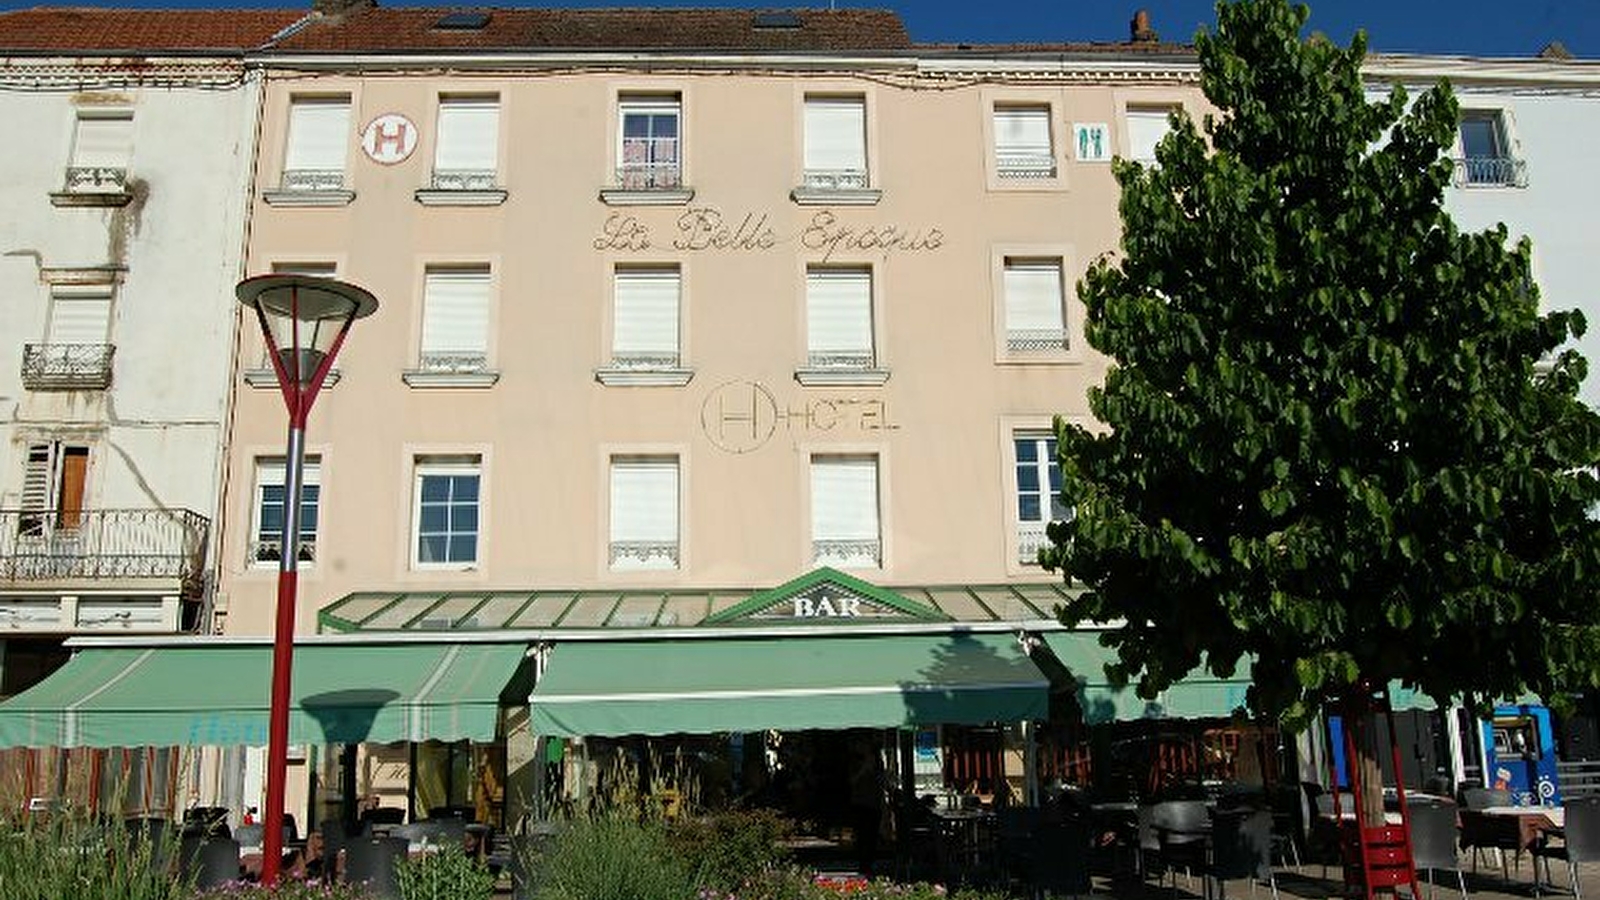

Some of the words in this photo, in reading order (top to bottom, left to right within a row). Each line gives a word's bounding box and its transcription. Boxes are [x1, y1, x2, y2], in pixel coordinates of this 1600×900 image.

[372, 122, 407, 155] H
[593, 211, 651, 251] La
[673, 208, 776, 251] Belle
[786, 399, 901, 431] HOTEL
[793, 596, 861, 617] BAR
